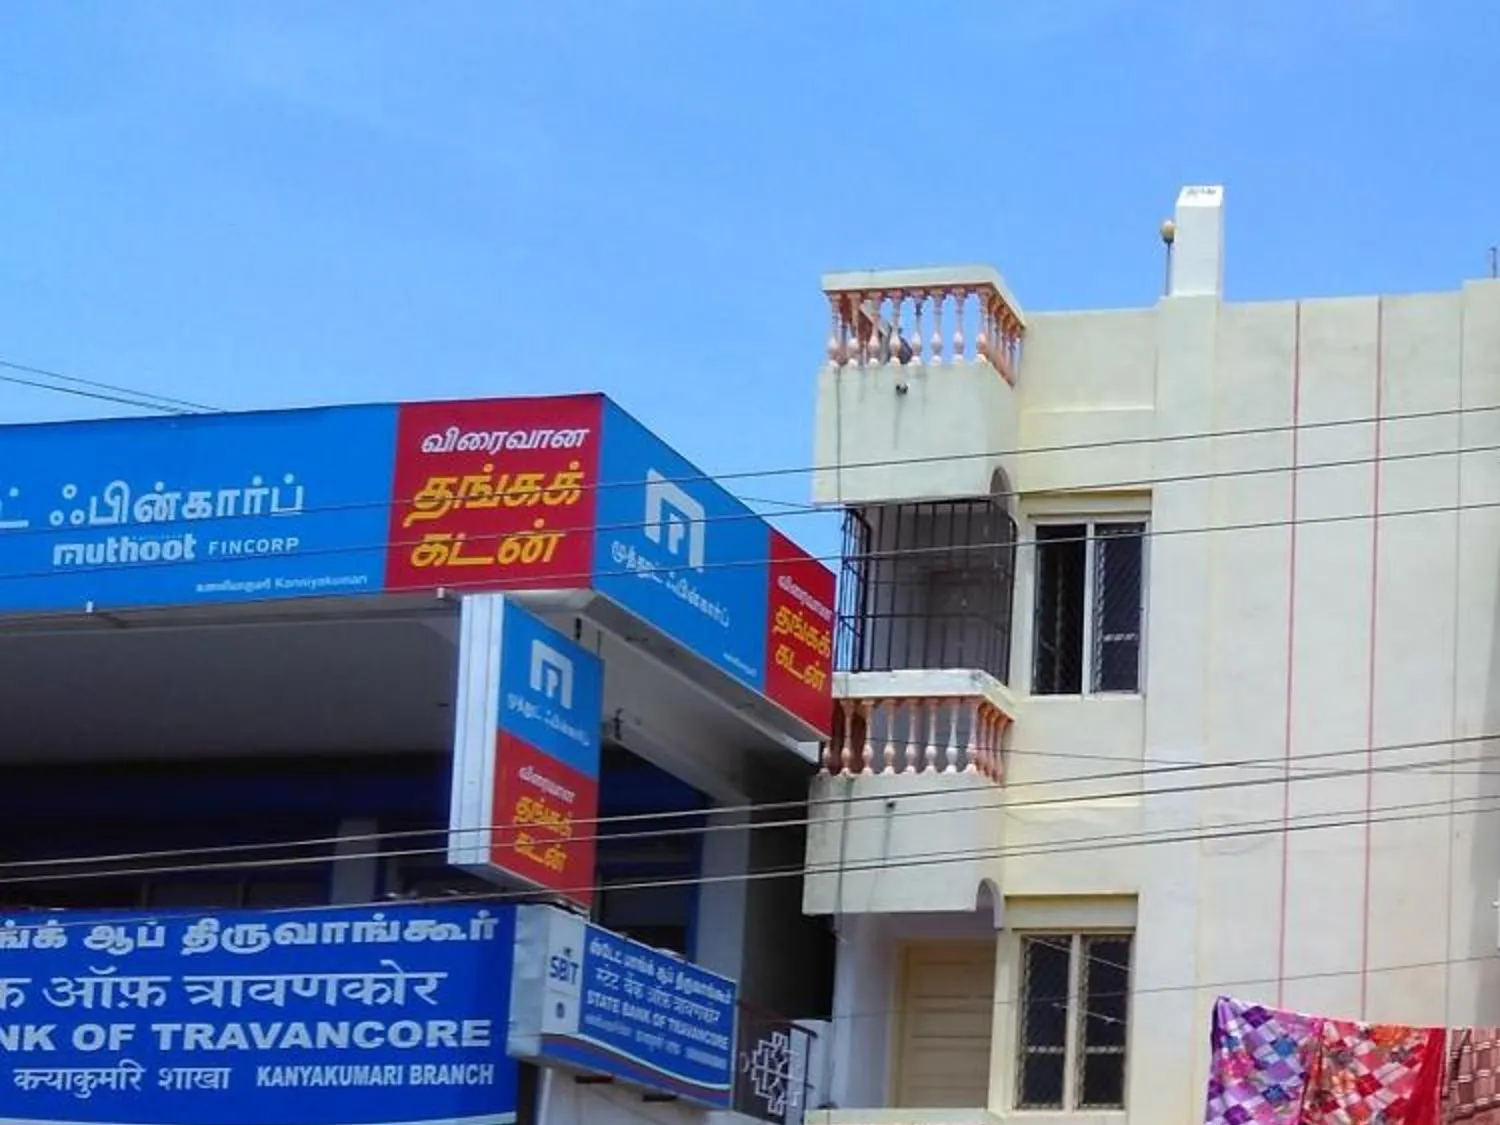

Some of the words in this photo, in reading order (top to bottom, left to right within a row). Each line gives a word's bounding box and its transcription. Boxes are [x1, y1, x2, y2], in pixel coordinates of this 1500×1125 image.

[420, 426, 590, 454] விரைவான
[403, 460, 585, 527] தங்கக்
[53, 534, 196, 566] muthoot
[208, 537, 300, 555] FINCORP
[411, 518, 567, 567] கடன்
[183, 959, 449, 1008] त्रावणकोर
[72, 1023, 137, 1051] OF
[152, 1019, 492, 1051] TRAVANCORE
[158, 1067, 232, 1090] शाखा
[257, 1064, 403, 1088] KANYAKUMARI
[409, 1062, 494, 1086] BRANCH
